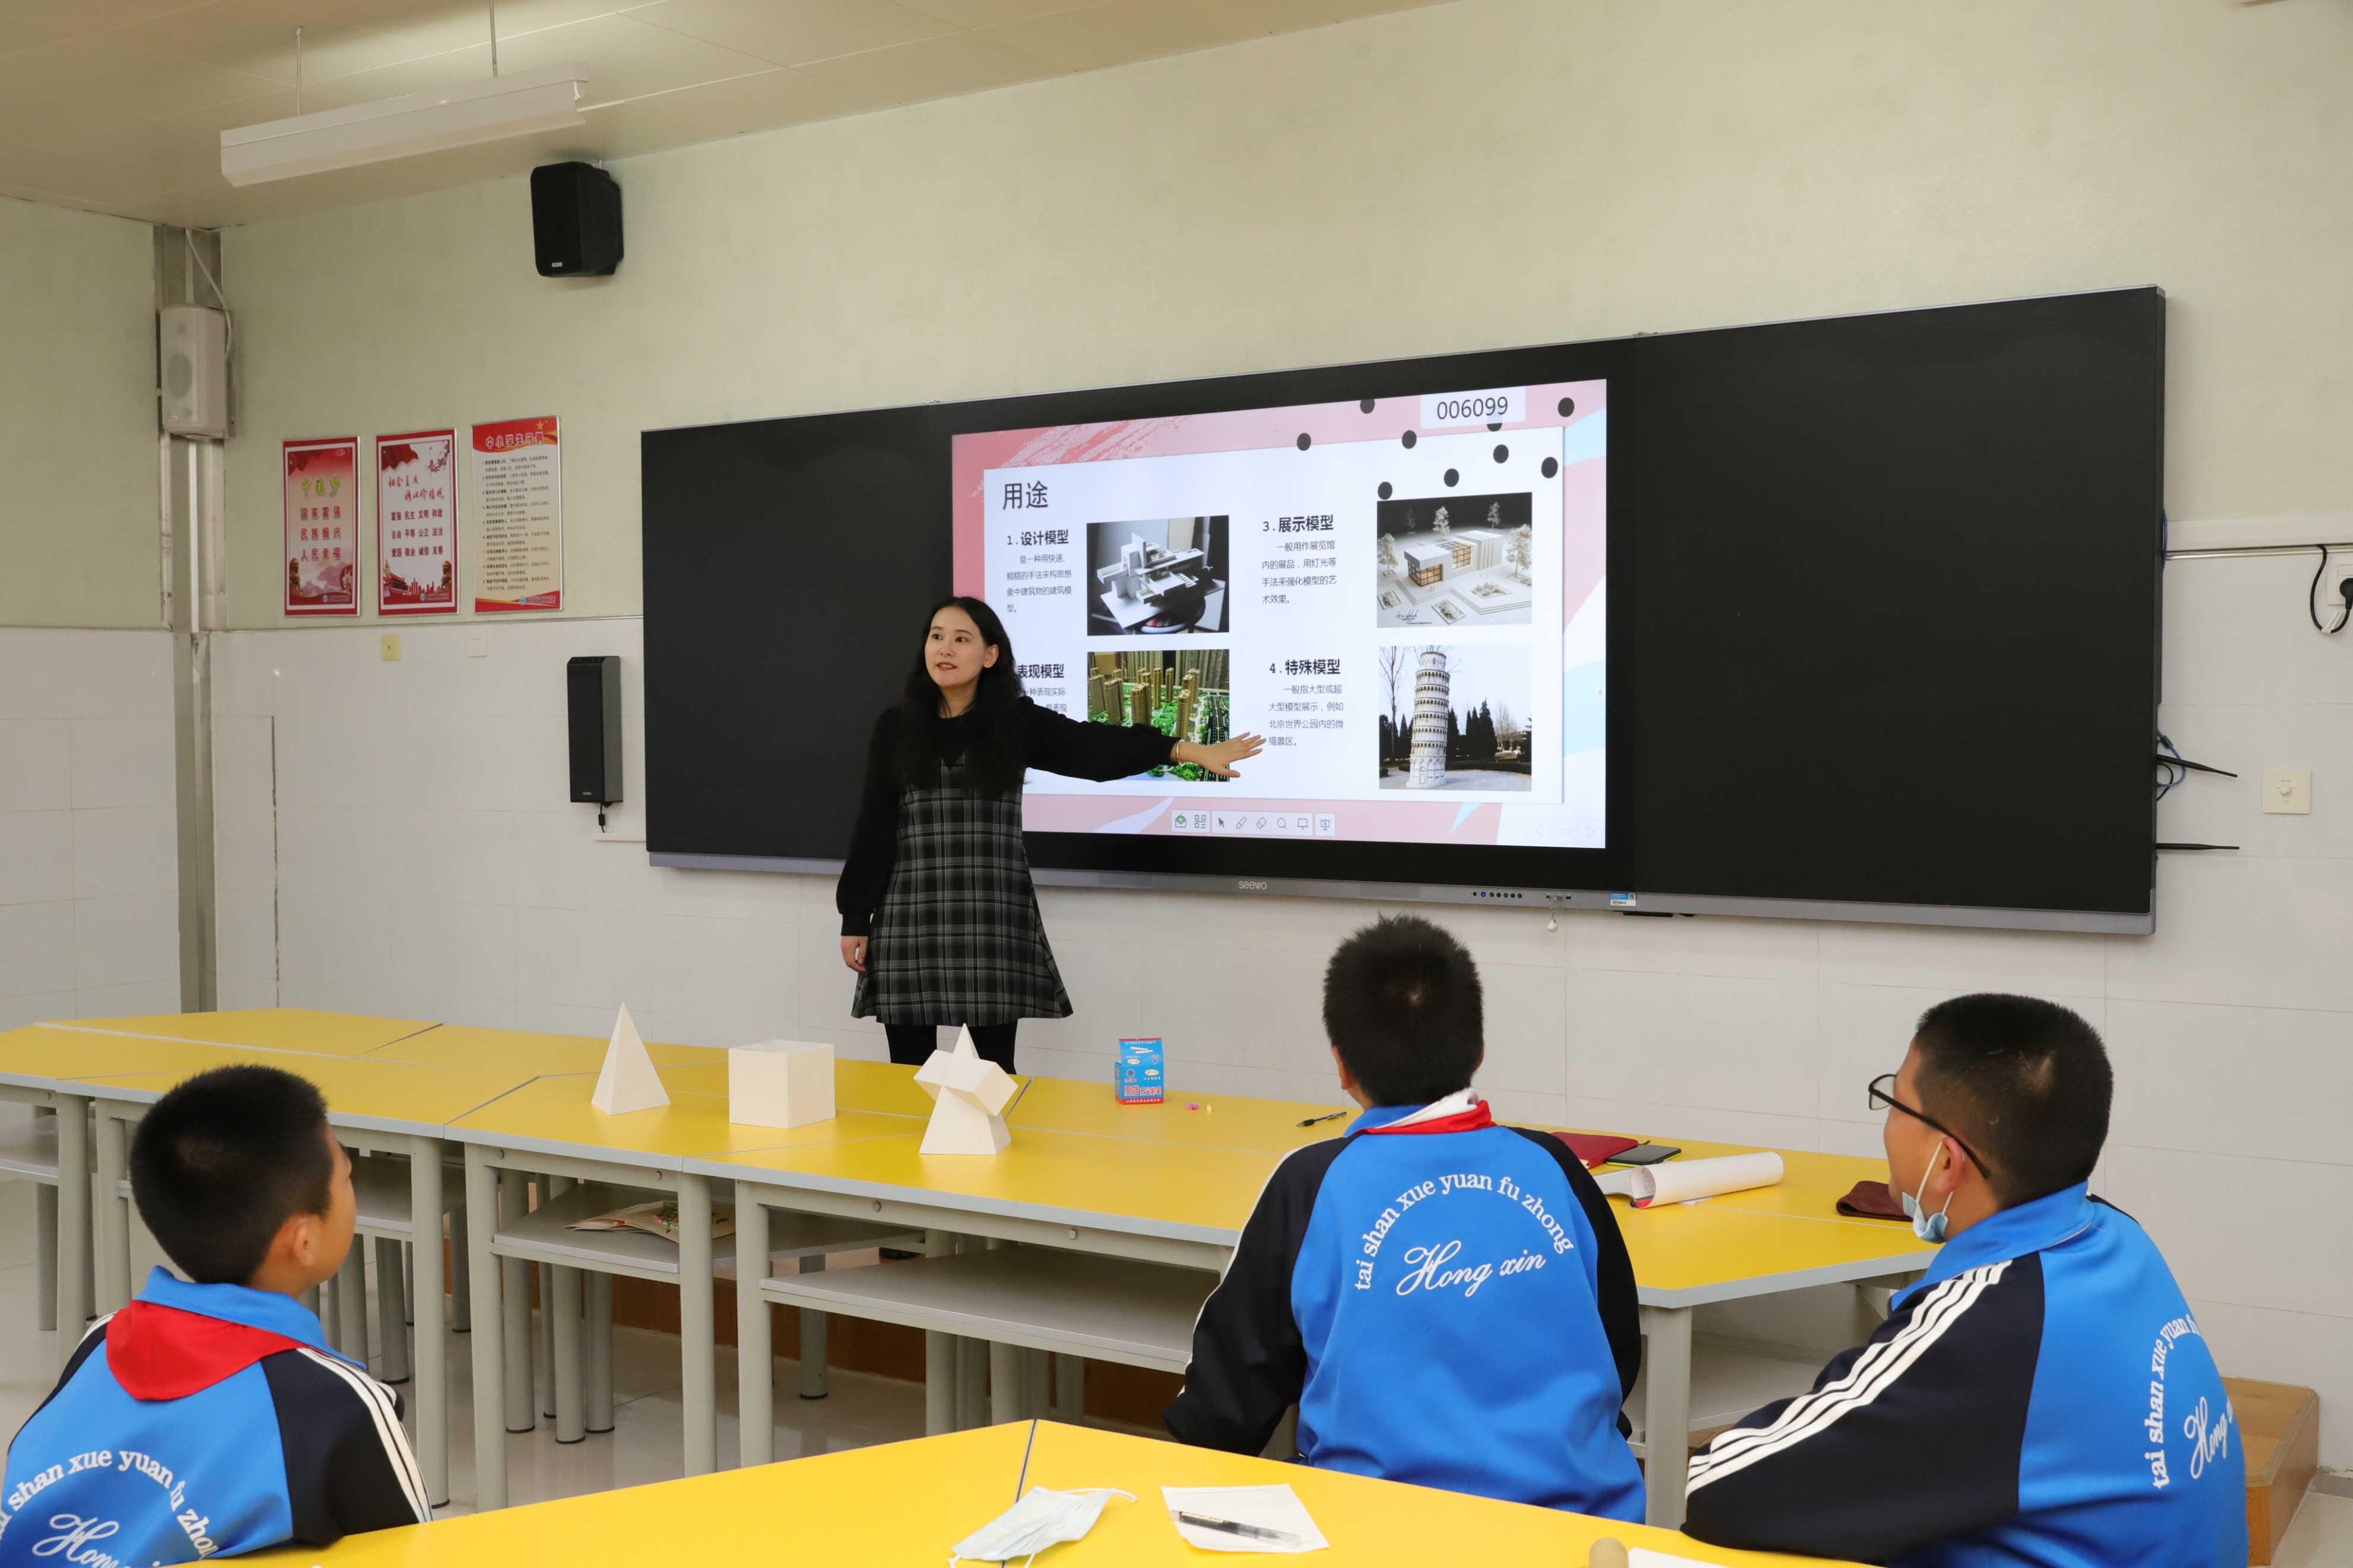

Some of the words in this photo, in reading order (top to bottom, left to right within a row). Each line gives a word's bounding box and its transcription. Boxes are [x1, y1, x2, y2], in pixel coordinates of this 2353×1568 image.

[1437, 396, 1508, 419] 006099
[485, 431, 543, 450] 中小学生守则
[301, 475, 341, 497] 中国梦
[1003, 480, 1048, 510] 用途
[301, 505, 341, 520] 国家富强
[391, 511, 402, 521] 富强
[405, 511, 415, 520] 民主
[418, 510, 429, 519] 文明
[432, 508, 443, 518] 和谐
[1263, 514, 1334, 533] 3.展示模型
[301, 526, 341, 540] 民族振兴
[392, 530, 402, 539] 自由
[405, 529, 415, 539] 平等
[418, 528, 429, 537] 公正
[432, 527, 443, 537] 法治
[1007, 529, 1069, 546] 1.设计模型
[301, 547, 341, 561] 人民幸福
[392, 548, 402, 558] 爱国
[405, 547, 415, 556] 敬业
[418, 546, 429, 556] 诚信
[433, 546, 443, 555] 友善
[1277, 540, 1336, 552] 一般用作展览馆
[1006, 570, 1071, 580] 粗糙的手法来构思想
[1262, 574, 1337, 587] 手法来强化模型的艺
[1006, 586, 1072, 597] 象中建筑物的建筑模
[1262, 594, 1290, 605] 术效果。
[1007, 604, 1017, 613] 型。
[1269, 659, 1340, 675] 4.特殊模型
[1283, 684, 1342, 694] 一般指大型或超
[1268, 719, 1344, 729] 北京世界公园内的微
[1268, 736, 1297, 746] 缩景区。
[1238, 881, 1267, 890] seewo
[1439, 1174, 1493, 1195] yuan
[1497, 1176, 1520, 1201] fu
[1396, 1180, 1436, 1211] xue
[1362, 1207, 1400, 1257] shan
[1522, 1193, 1574, 1255] zhong
[1354, 1260, 1374, 1290] tai
[1396, 1240, 1493, 1297] Hong
[1499, 1249, 1546, 1276] xin
[2160, 1318, 2189, 1350] yuan
[2151, 1339, 2168, 1381] xue
[2144, 1381, 2164, 1443] shan
[2183, 1396, 2228, 1480] Hong
[2144, 1449, 2170, 1489] tai
[8, 1464, 65, 1512] shan
[68, 1450, 112, 1474] xue
[118, 1451, 174, 1489] yuan
